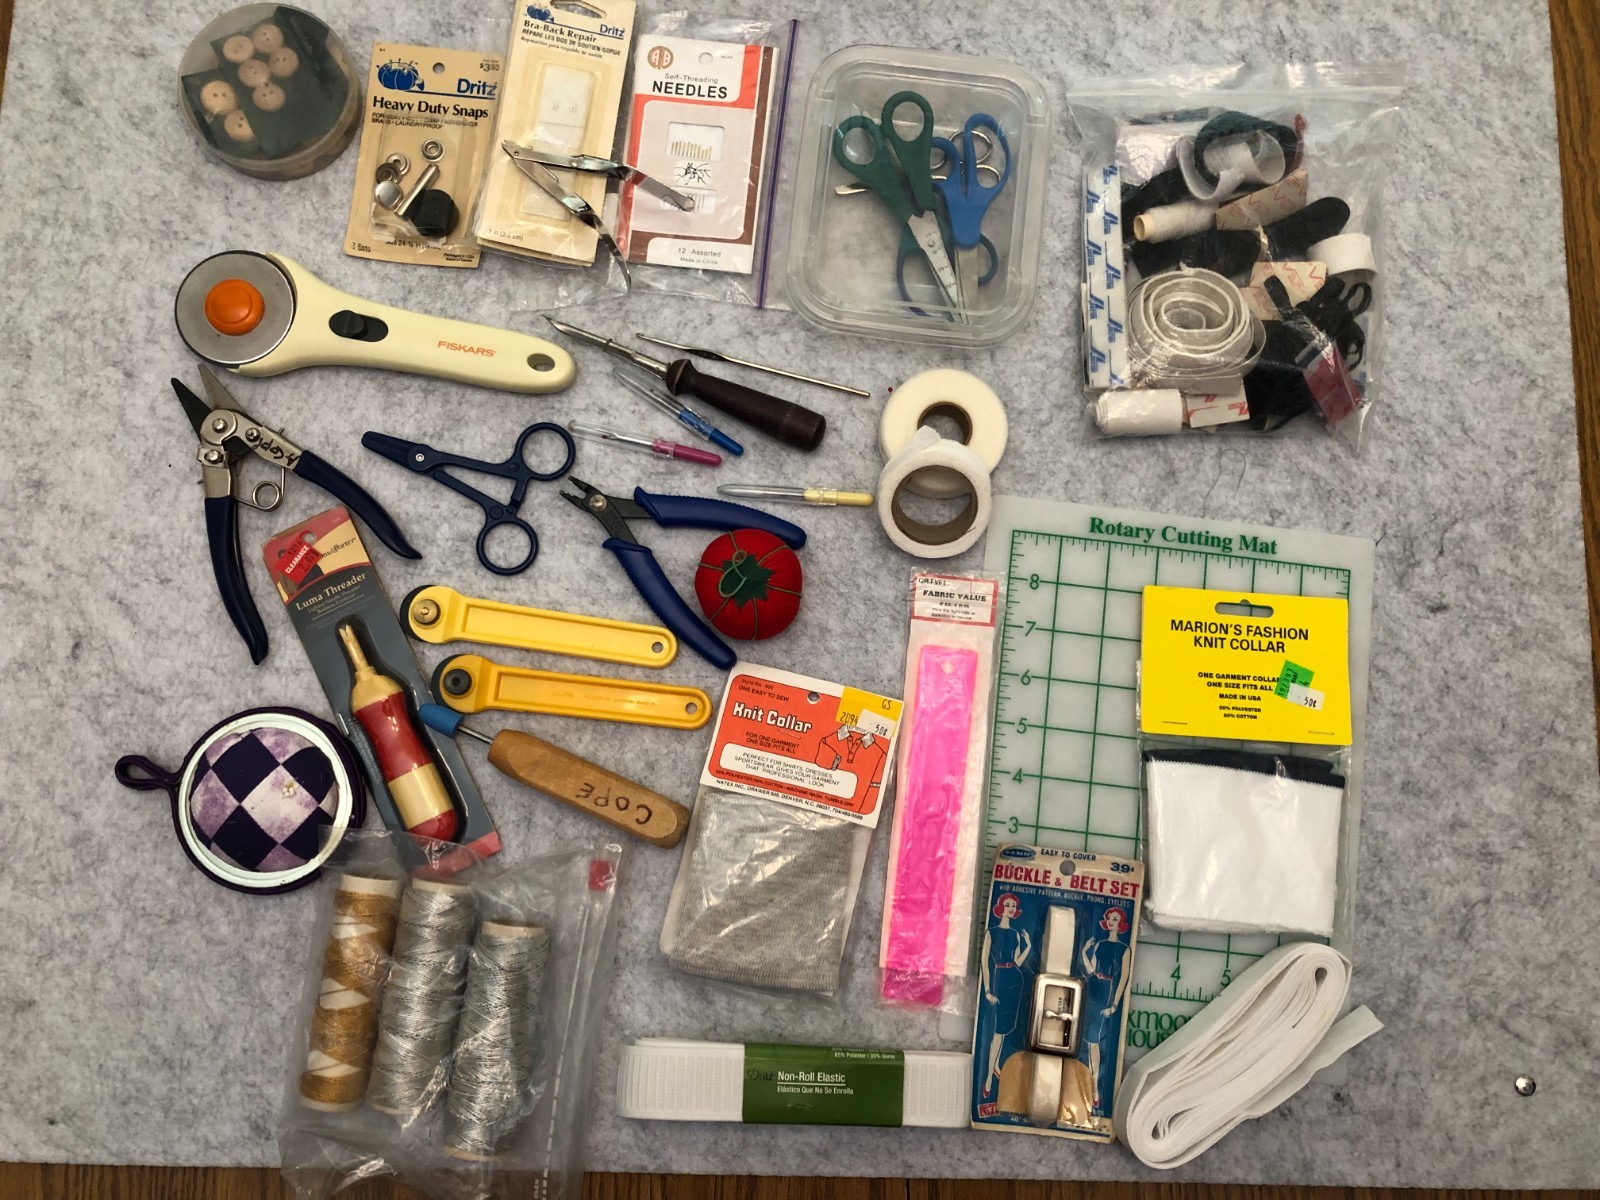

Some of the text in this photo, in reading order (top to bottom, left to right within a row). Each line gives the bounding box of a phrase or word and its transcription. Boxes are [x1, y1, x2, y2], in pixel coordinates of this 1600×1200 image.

[524, 20, 597, 42] Bra-Back Repair
[600, 24, 626, 37] Dritz
[457, 78, 498, 96] Dritz
[665, 73, 718, 84] Self-Threading
[652, 80, 728, 99] NEEDLES
[372, 96, 489, 120] Heavy Duty Snaps
[691, 250, 722, 258] Assorted
[438, 340, 495, 357] FISKARS
[1088, 517, 1278, 555] Rotary Cutting Mat
[285, 544, 310, 574] CLEARANCE
[1029, 574, 1040, 590] 8
[295, 594, 323, 611] Luma
[323, 573, 366, 596] Threader
[923, 589, 987, 602] FABRIC VALUE
[1025, 620, 1037, 638] 7
[1170, 619, 1308, 640] MARION'S FASHION
[1194, 636, 1285, 653] KNIT COLLAR
[1020, 669, 1032, 686] 6
[751, 688, 767, 696] EASY
[732, 701, 812, 733] Knit Collar
[1016, 717, 1028, 735] 5
[772, 738, 799, 748] GARMENT
[743, 752, 768, 762] PERFECT
[776, 766, 793, 774] GIVES
[812, 775, 840, 786] GARMENT
[1012, 767, 1023, 784] 4
[575, 782, 653, 825] COPE
[1008, 816, 1019, 834] 3
[1041, 848, 1058, 857] EASY
[1072, 852, 1096, 861] COVER
[994, 864, 1140, 898] BUCKLE & BELT SET
[1012, 886, 1036, 895] ADHESIVE
[1170, 964, 1231, 987] 4 5
[1128, 1009, 1192, 1032] xmoo
[778, 1071, 815, 1082] Non-Roll
[817, 1072, 846, 1083] Elastic
